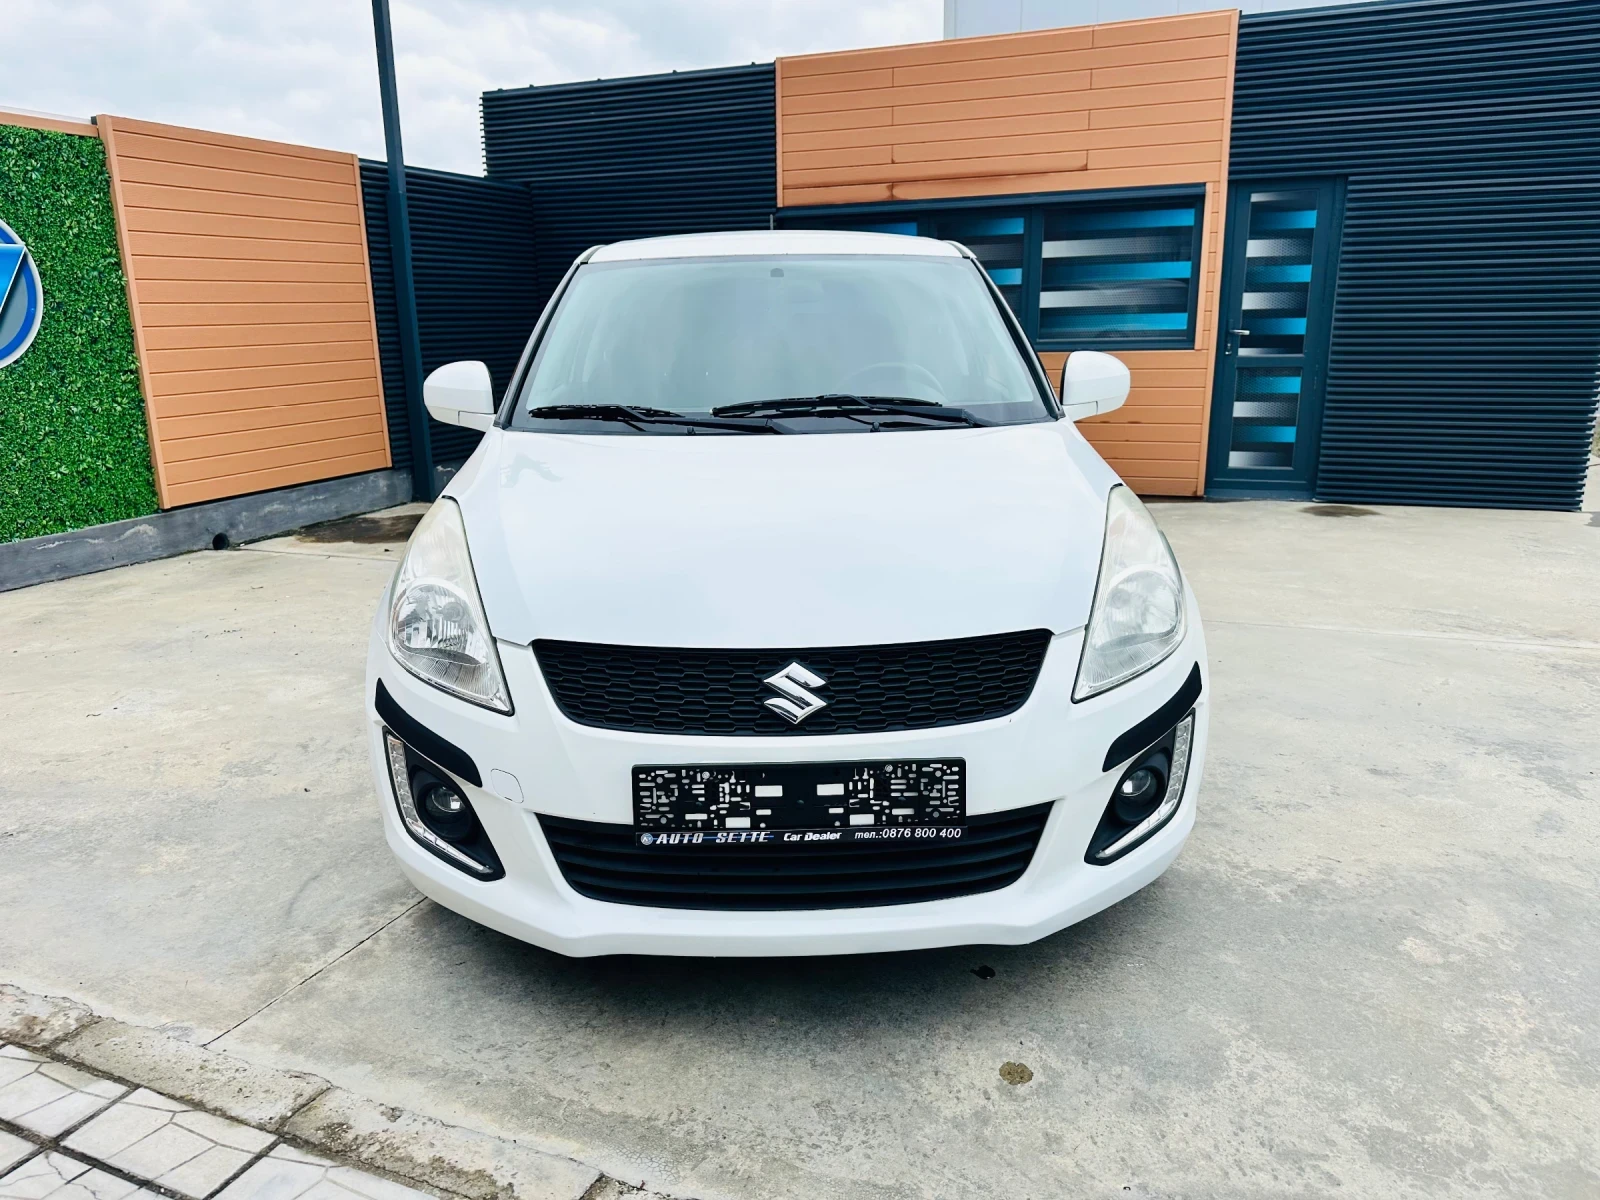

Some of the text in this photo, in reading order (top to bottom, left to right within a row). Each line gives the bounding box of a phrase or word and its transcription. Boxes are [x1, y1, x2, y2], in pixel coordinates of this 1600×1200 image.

[655, 831, 771, 845] AUTO SETTE
[783, 831, 843, 841] Car Dealer
[914, 828, 937, 839] 800
[939, 828, 962, 839] 400
